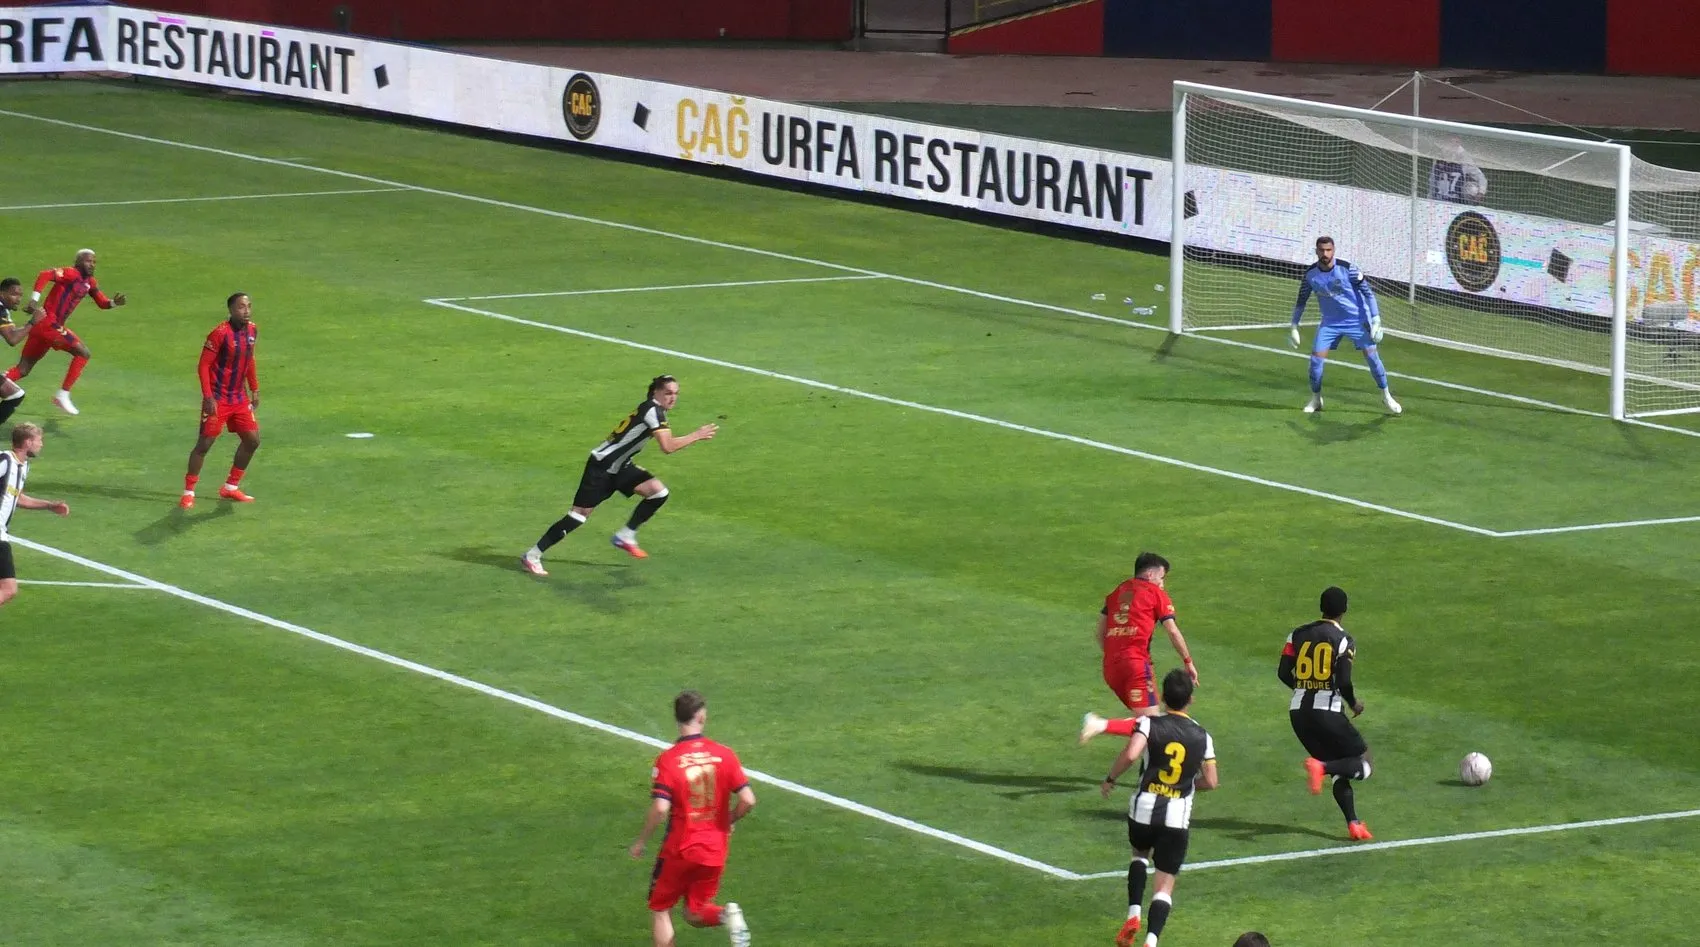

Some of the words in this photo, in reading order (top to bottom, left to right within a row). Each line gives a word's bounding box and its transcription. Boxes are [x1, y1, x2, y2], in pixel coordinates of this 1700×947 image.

[117, 18, 356, 95] RESTAURANT
[676, 95, 749, 160] ÇAĞ
[762, 112, 861, 180] URFA
[874, 129, 1153, 226] RESTAURANT
[1296, 641, 1332, 680] 60
[1158, 741, 1187, 785] 3
[1148, 782, 1181, 799] OSMAN
